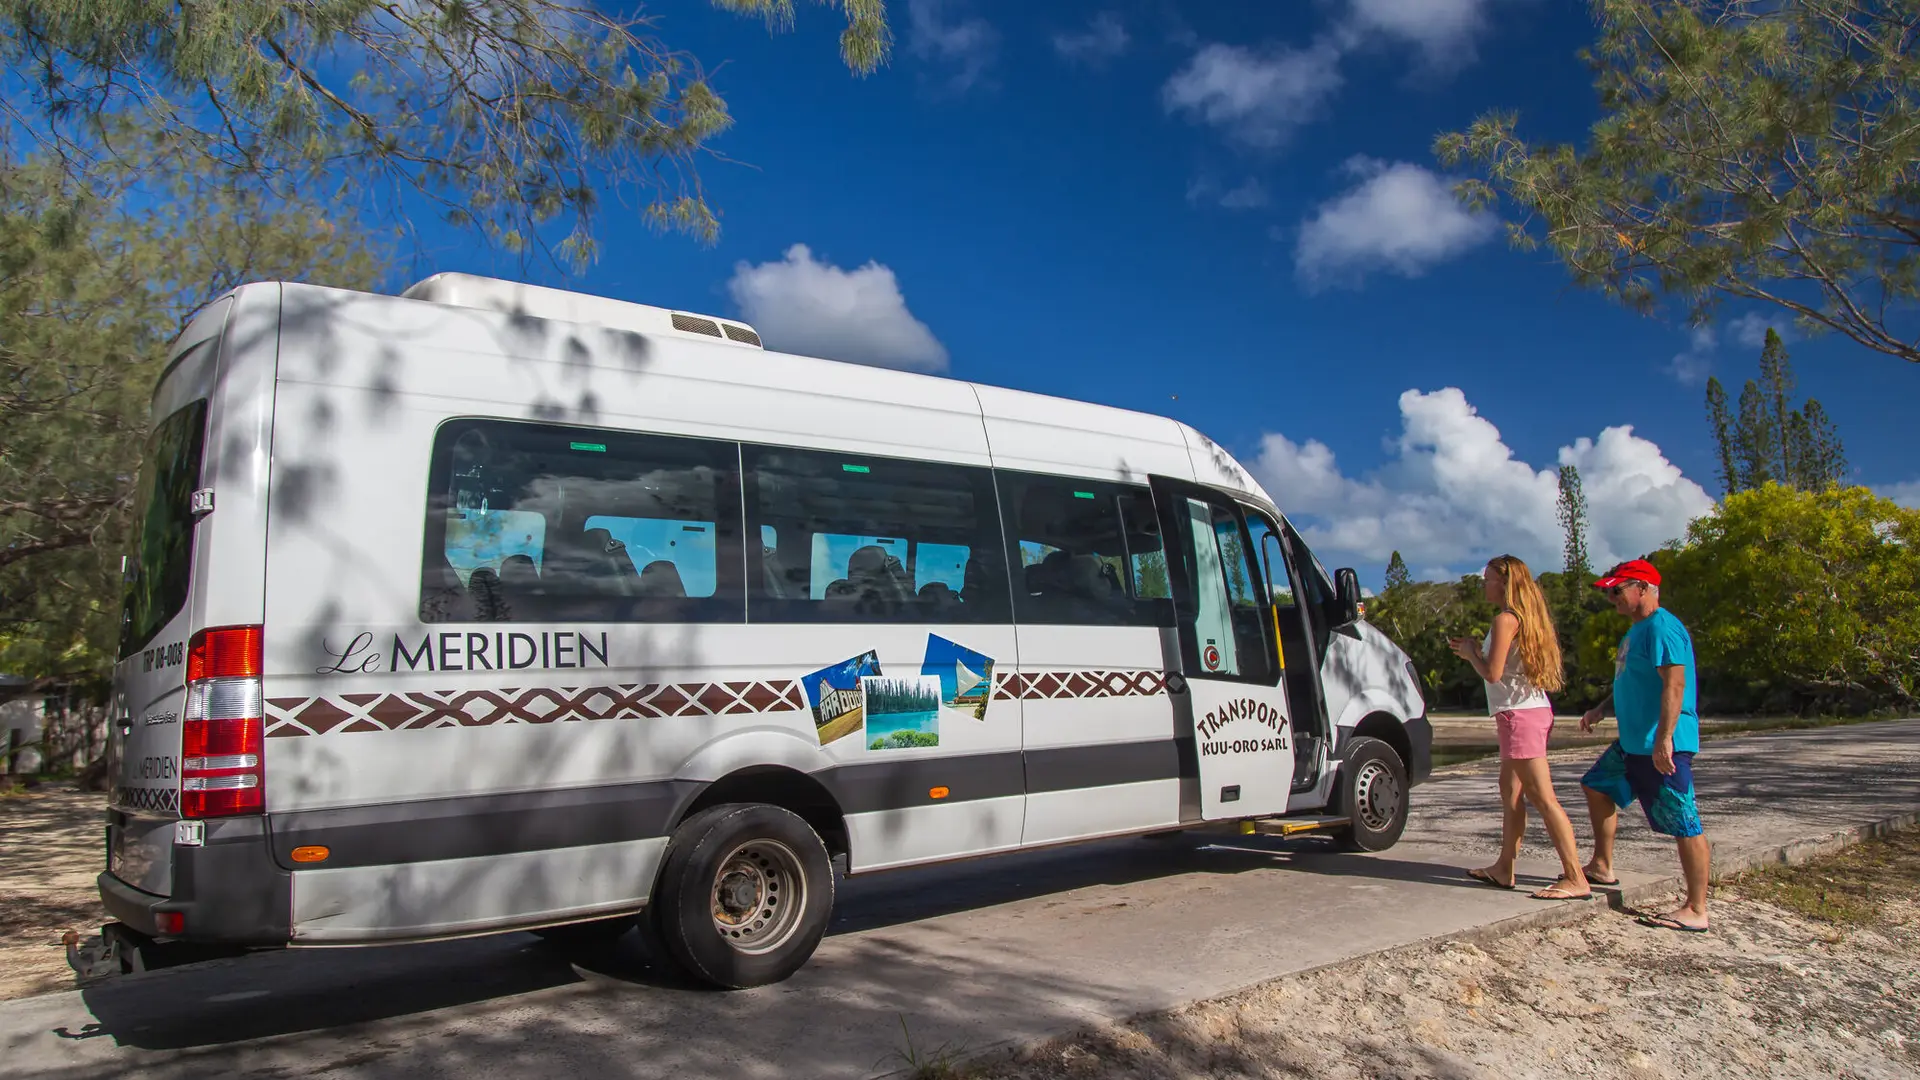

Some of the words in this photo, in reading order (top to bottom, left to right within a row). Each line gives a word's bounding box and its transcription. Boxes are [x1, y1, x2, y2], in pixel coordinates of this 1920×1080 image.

[155, 641, 183, 670] 08-008
[316, 631, 380, 674] Le
[390, 632, 609, 672] MERIDIEN
[1197, 698, 1288, 740] TRANSPORT
[1202, 739, 1259, 756] KUU-ORO
[1261, 737, 1288, 751] SARL
